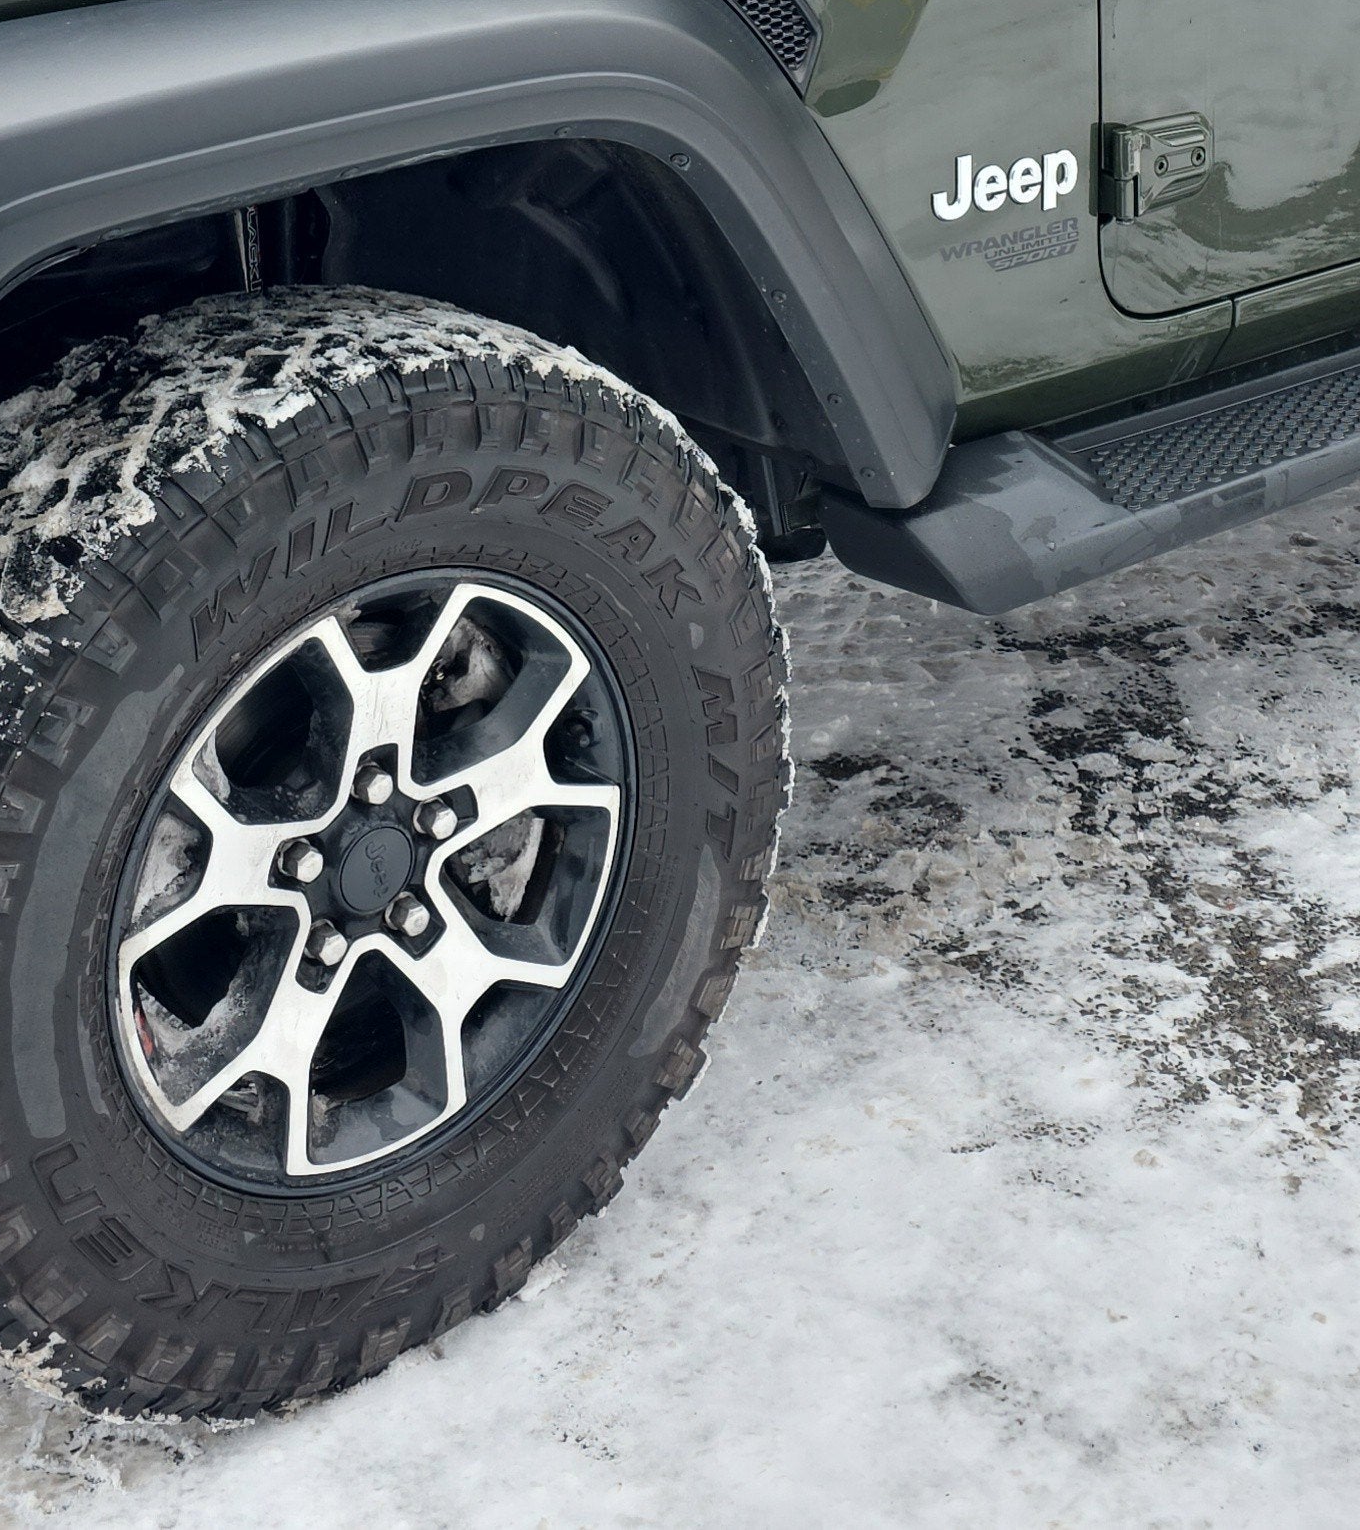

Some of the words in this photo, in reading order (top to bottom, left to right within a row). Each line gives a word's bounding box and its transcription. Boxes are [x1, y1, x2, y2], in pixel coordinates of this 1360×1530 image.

[930, 149, 1079, 221] Jeep
[940, 217, 1079, 262] WRANGLER
[984, 231, 1079, 260] UNLIMITED
[990, 242, 1078, 271] SPORT
[191, 465, 707, 662] WILDPEAK
[691, 664, 741, 861] M/T
[364, 841, 389, 898] Jeep
